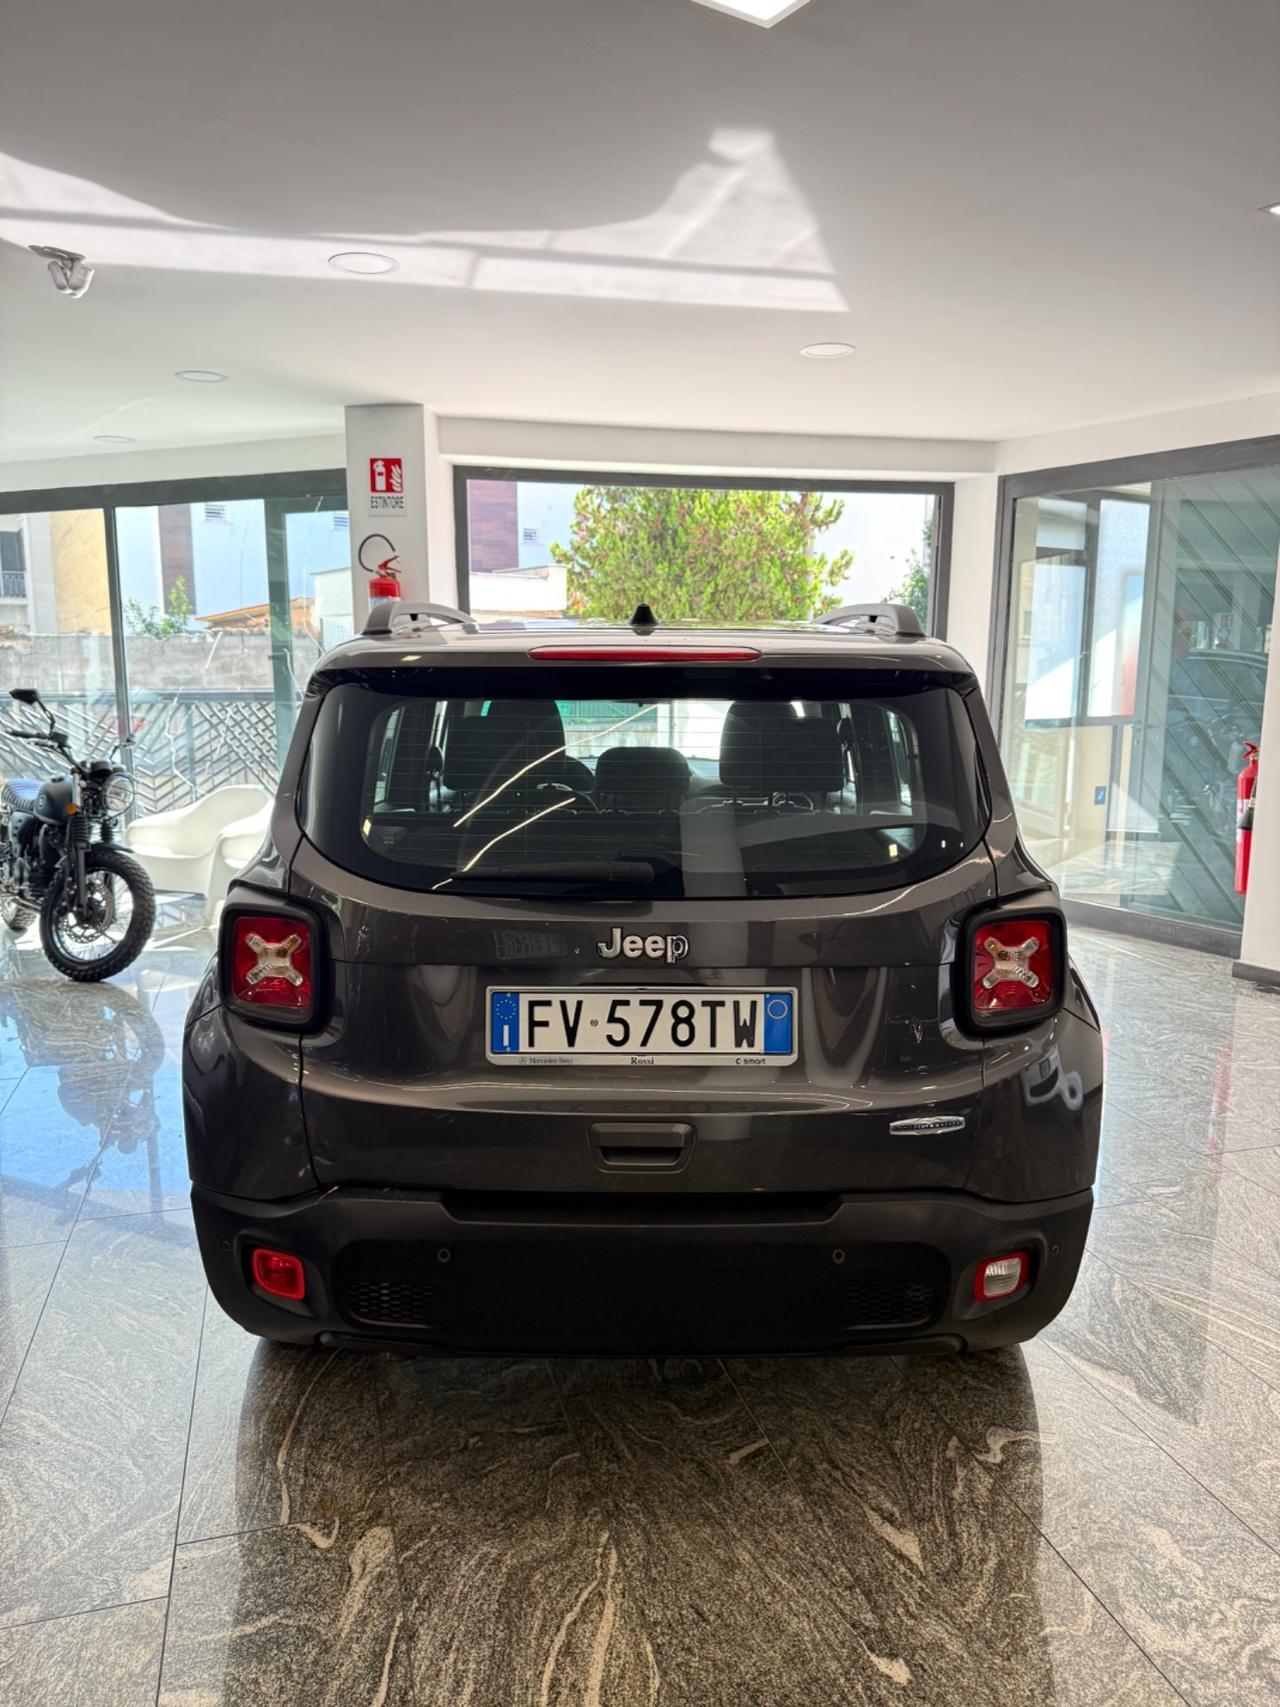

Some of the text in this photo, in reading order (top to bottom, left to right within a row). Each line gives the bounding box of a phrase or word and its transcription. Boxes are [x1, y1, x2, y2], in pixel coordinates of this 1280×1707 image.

[370, 495, 404, 510] ESTINTORE
[597, 927, 690, 963] Jeep
[527, 999, 758, 1048] FV 578TW
[630, 1056, 655, 1065] Rossi
